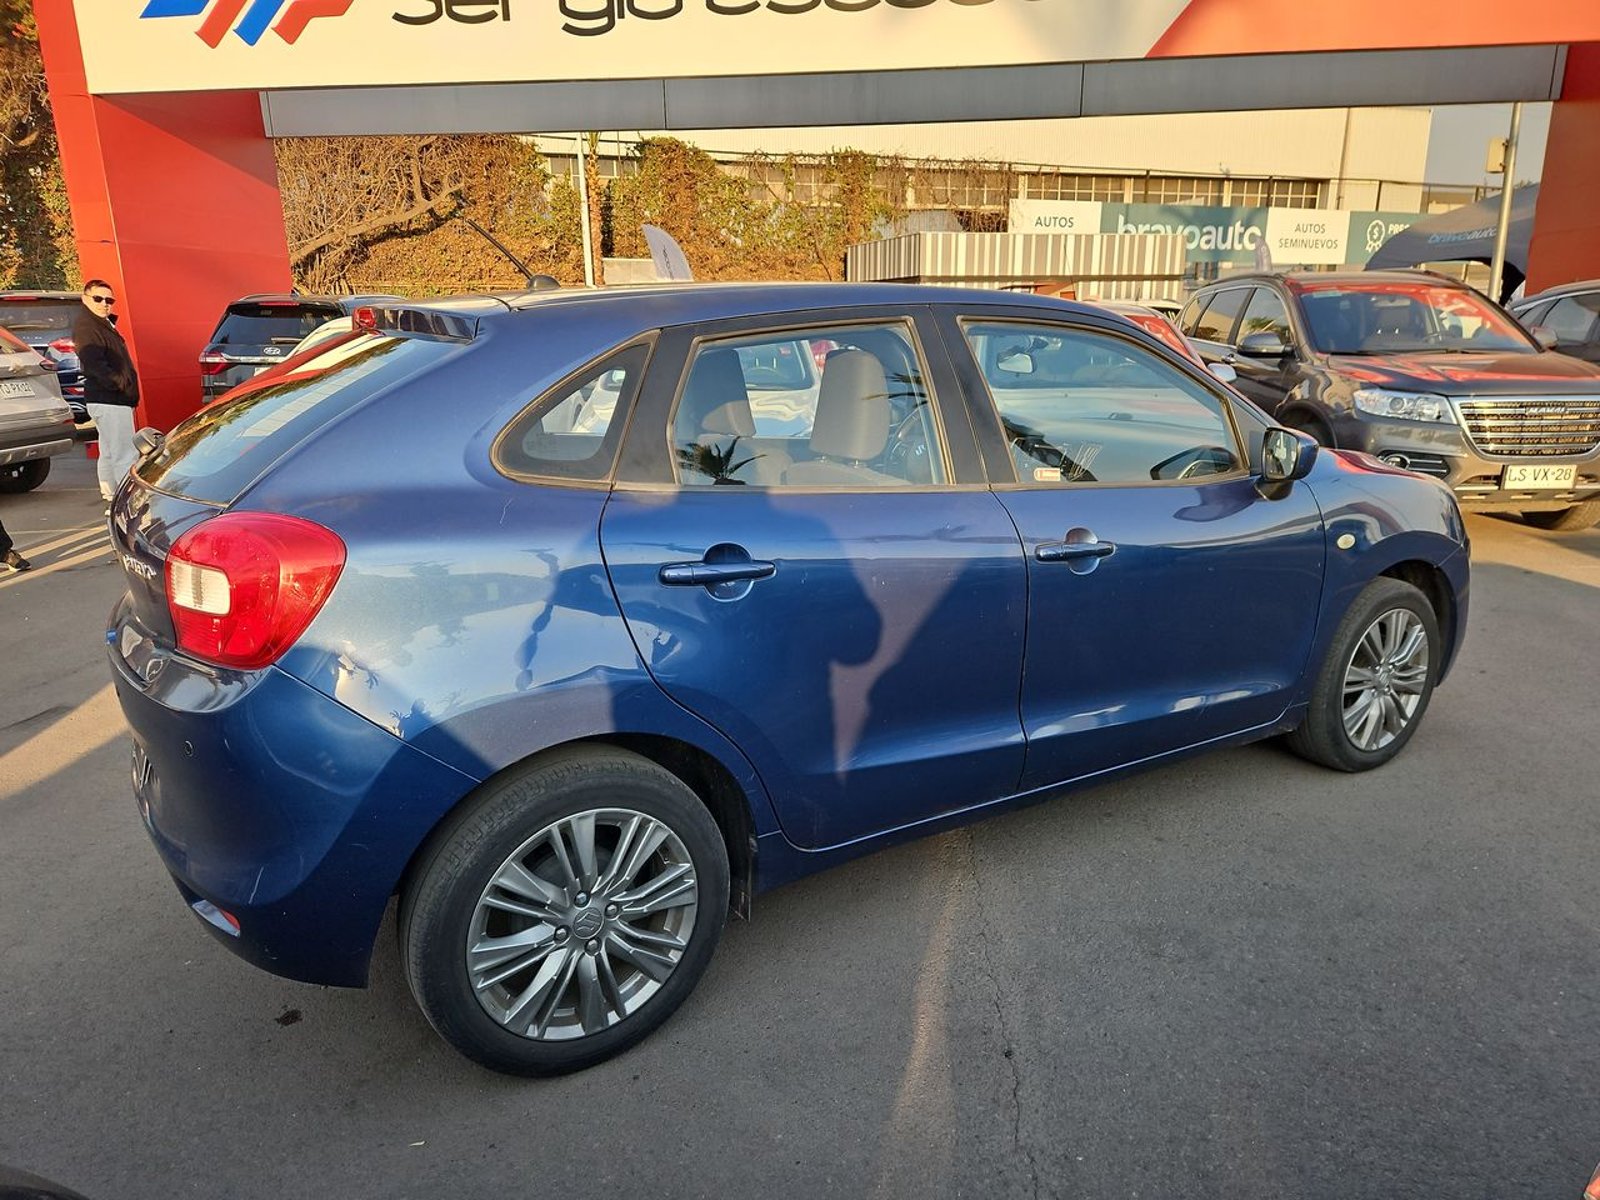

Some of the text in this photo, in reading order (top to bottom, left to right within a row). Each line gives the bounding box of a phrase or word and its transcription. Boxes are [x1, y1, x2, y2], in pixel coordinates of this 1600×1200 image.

[1034, 216, 1074, 228] AUTOS
[1294, 223, 1326, 234] AUTOS
[1278, 238, 1338, 249] SEMINUEVOS
